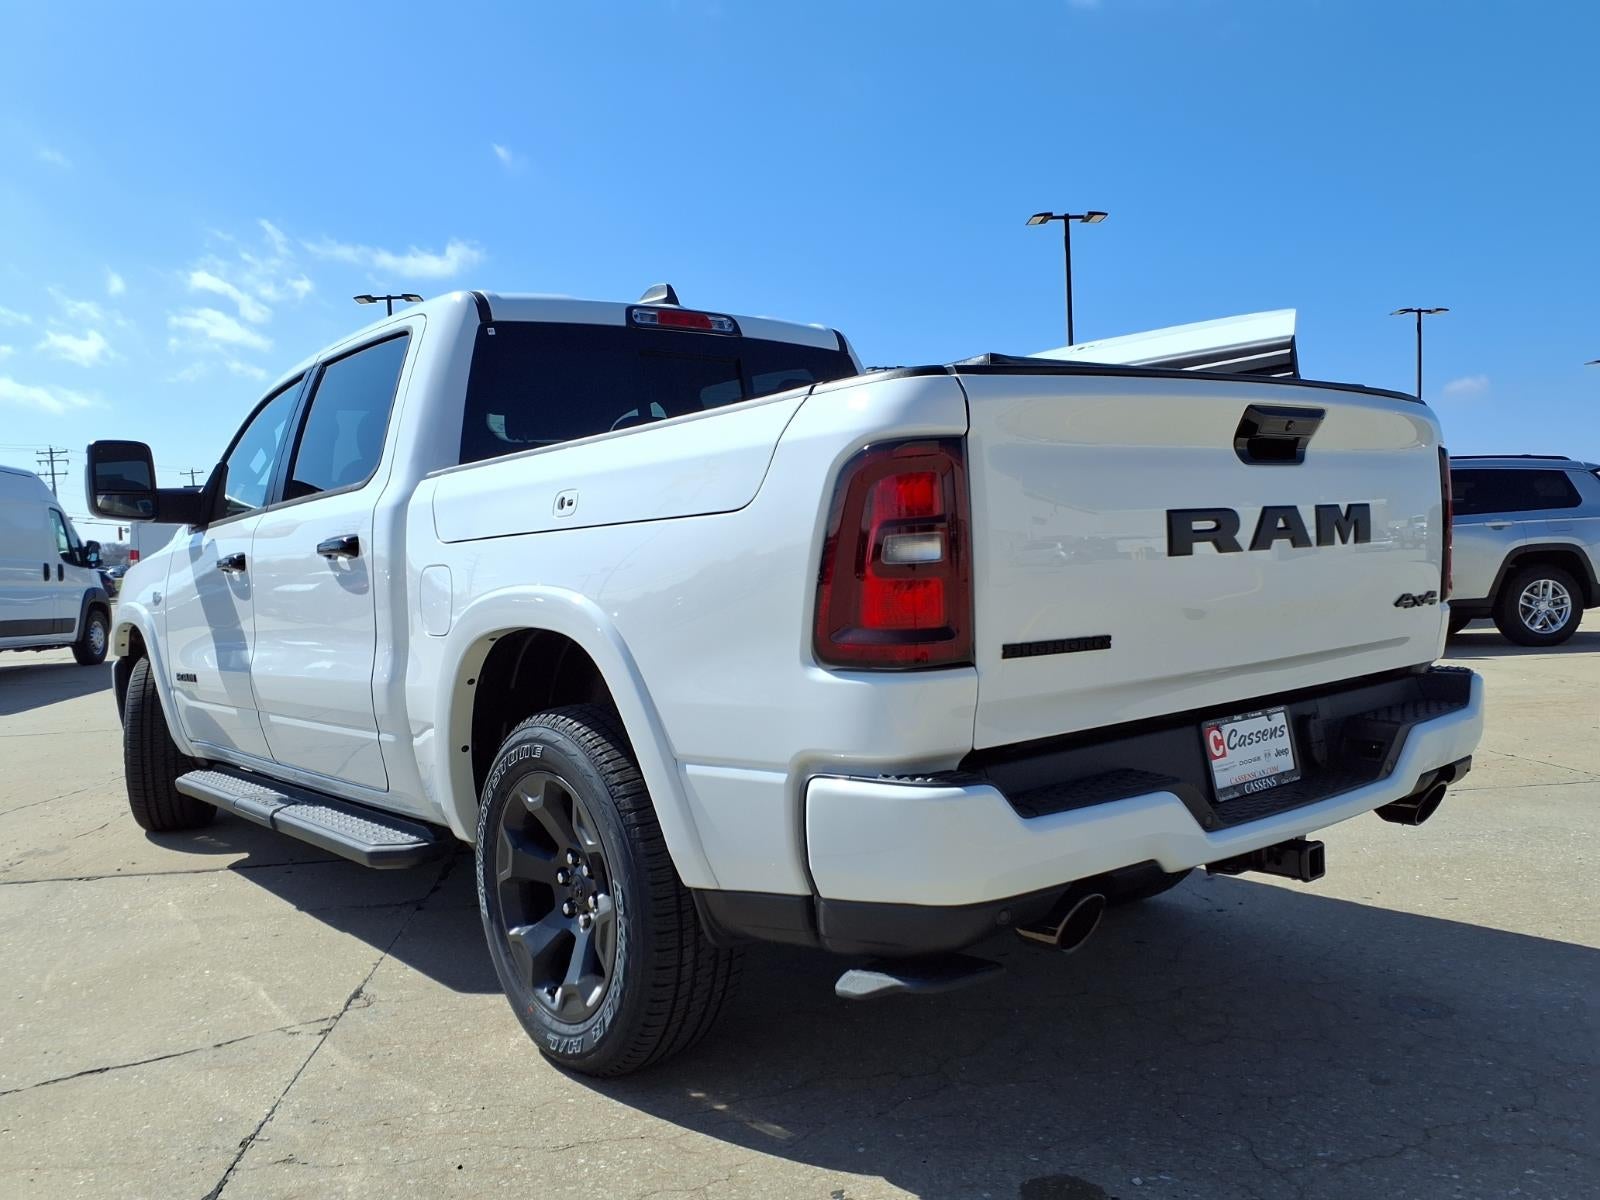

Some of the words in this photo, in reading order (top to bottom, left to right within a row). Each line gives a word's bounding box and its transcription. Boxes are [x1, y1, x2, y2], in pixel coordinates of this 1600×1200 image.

[1166, 503, 1372, 557] RAM
[1394, 591, 1438, 608] 4x4
[1227, 724, 1286, 751] Cassens
[1274, 747, 1290, 758] Jeep
[1244, 776, 1278, 795] CASSENS
